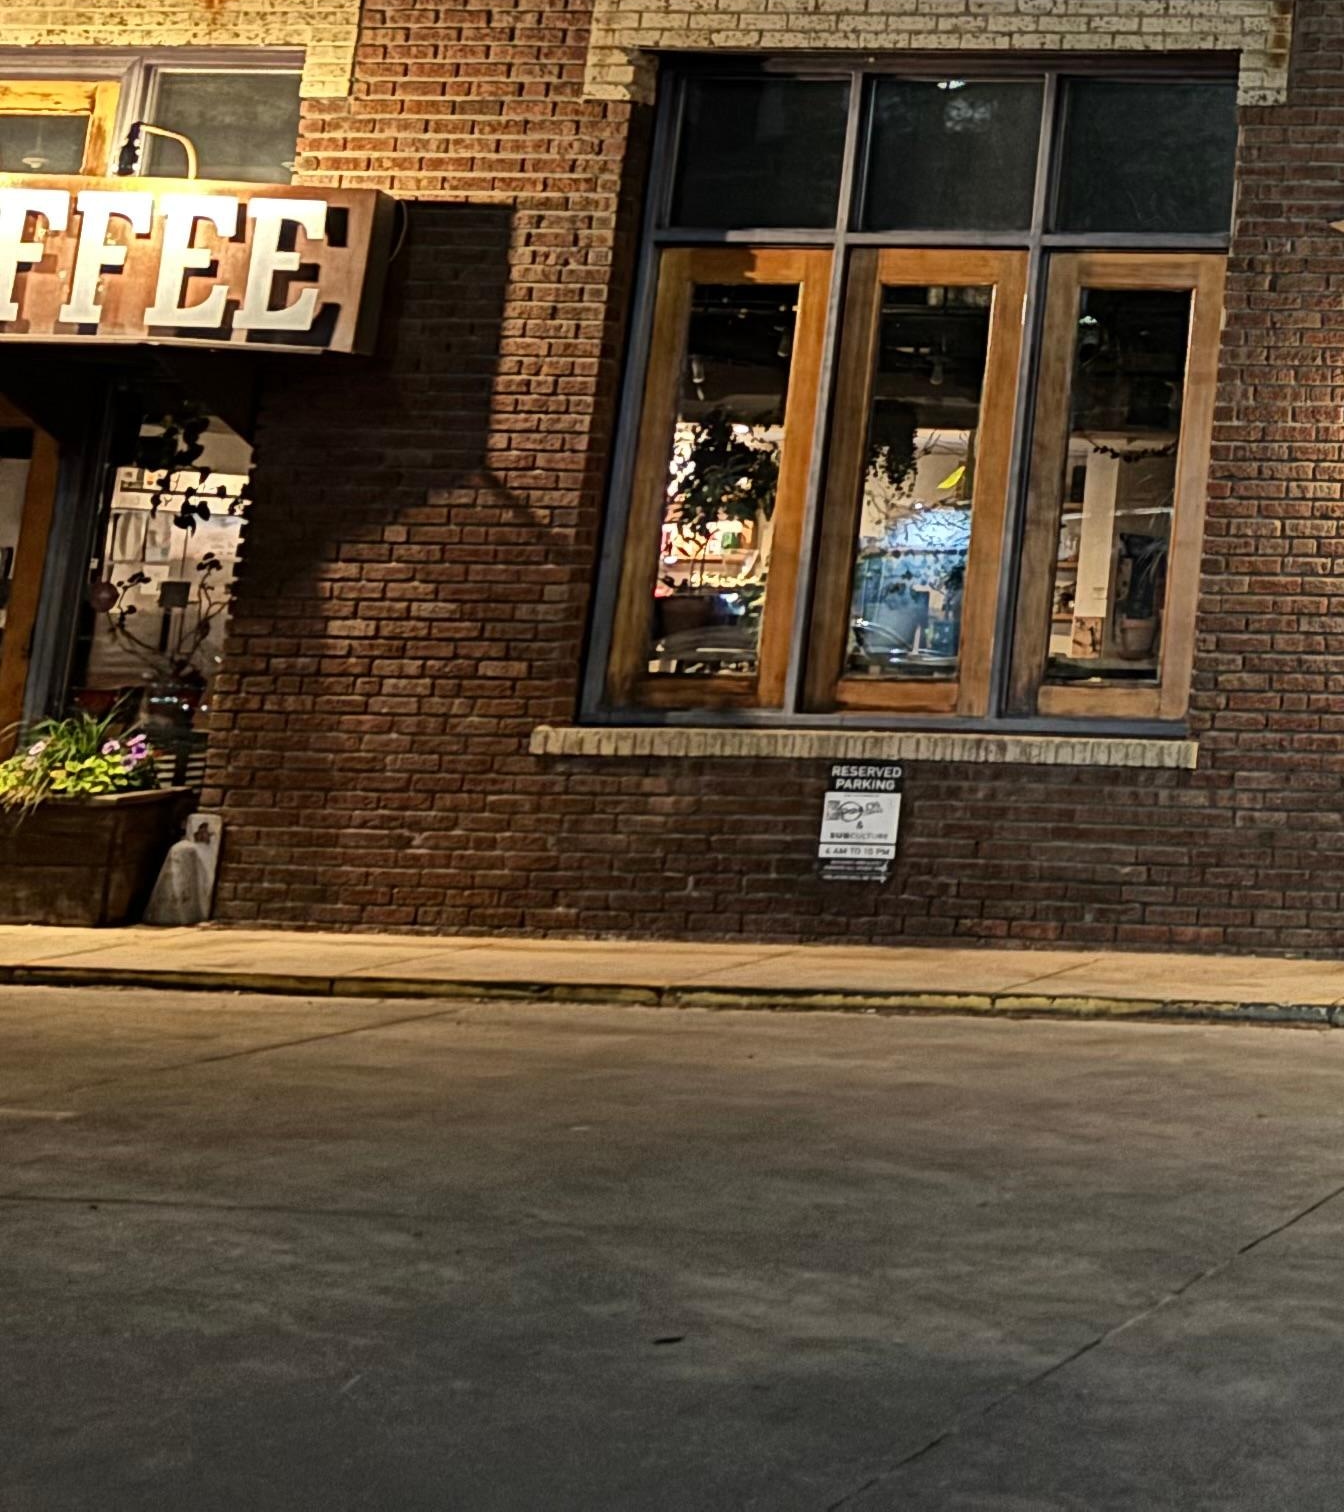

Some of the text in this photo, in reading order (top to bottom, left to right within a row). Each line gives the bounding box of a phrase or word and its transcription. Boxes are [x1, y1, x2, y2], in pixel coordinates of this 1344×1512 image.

[0, 188, 328, 331] FFEE
[831, 765, 902, 778] RESERVED
[835, 778, 896, 791] PARKING
